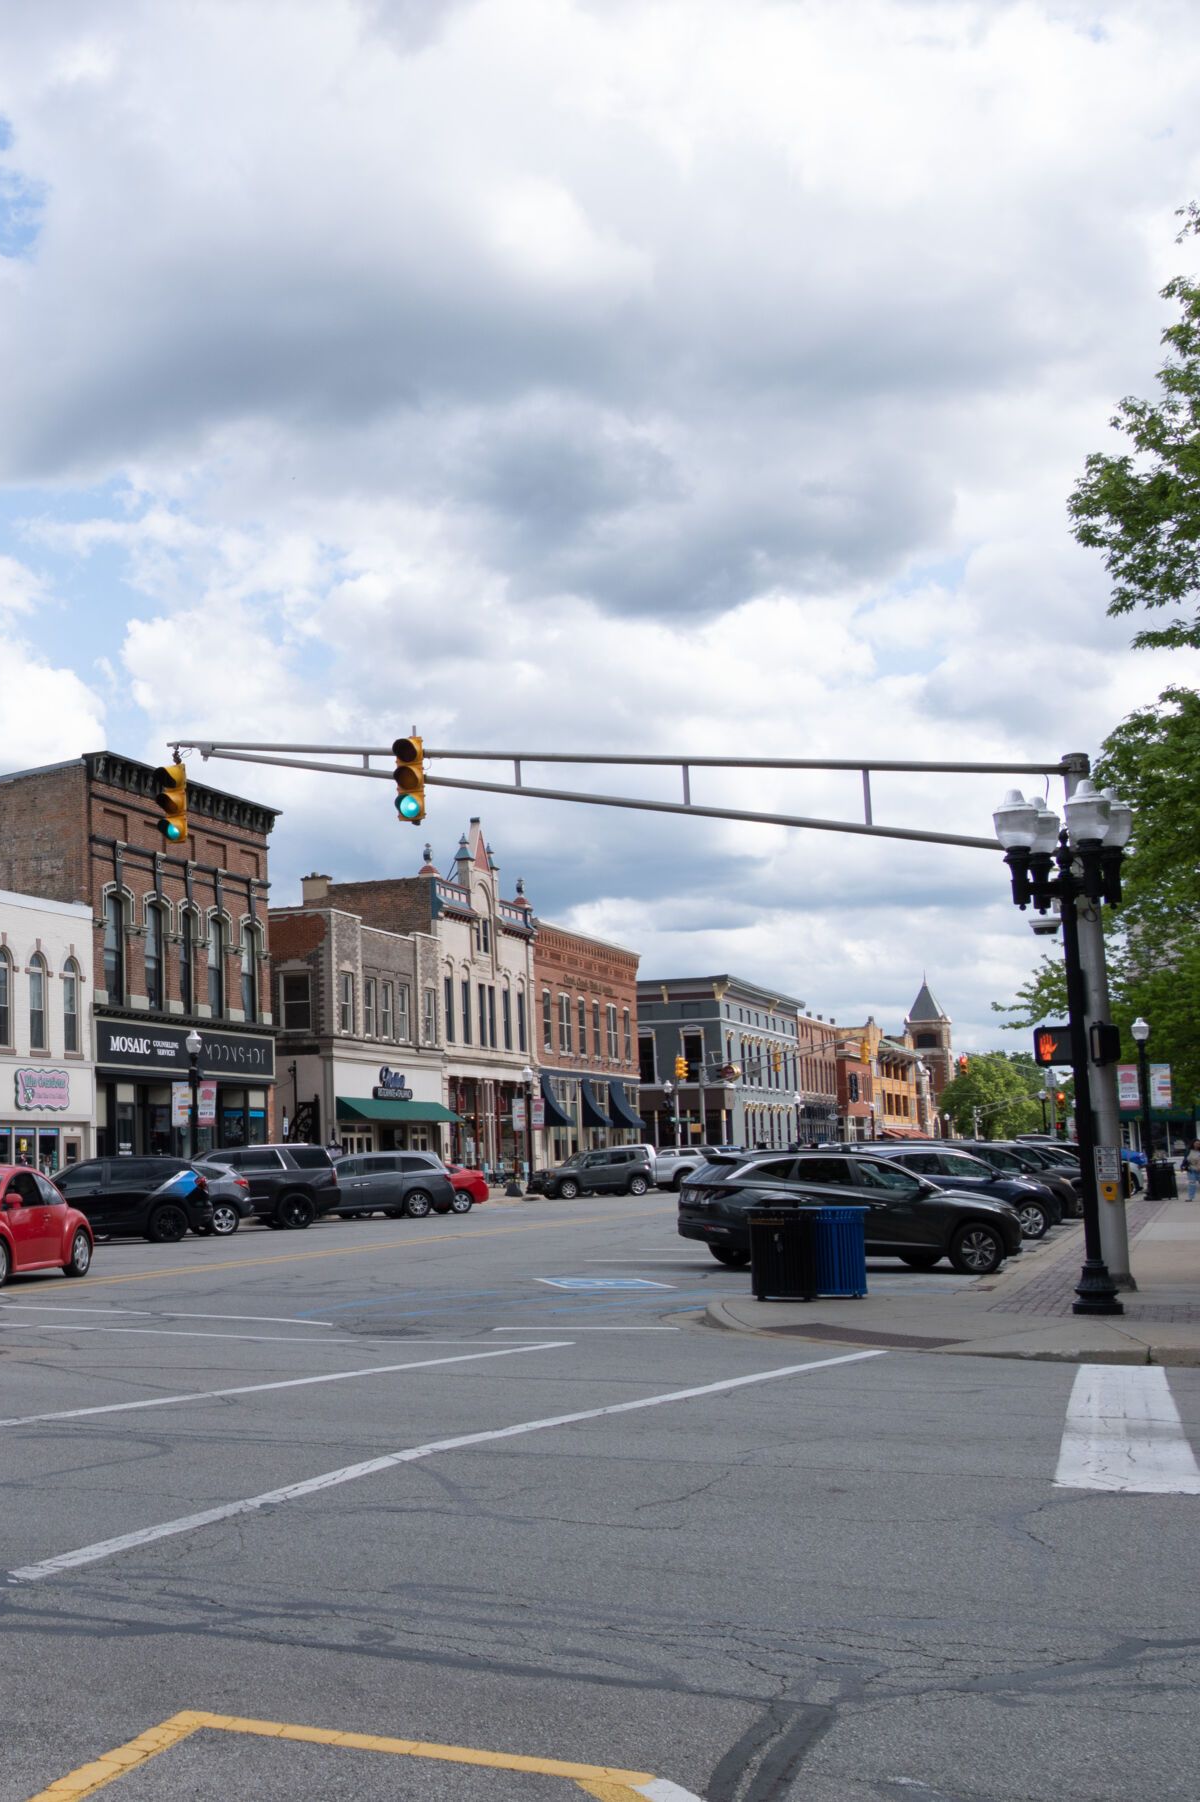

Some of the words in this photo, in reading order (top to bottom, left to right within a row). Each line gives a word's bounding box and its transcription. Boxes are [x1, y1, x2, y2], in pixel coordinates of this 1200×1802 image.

[109, 1035, 151, 1055] MOSAIC
[152, 1040, 179, 1049] COUNSELING
[156, 1048, 176, 1057] SERVICES
